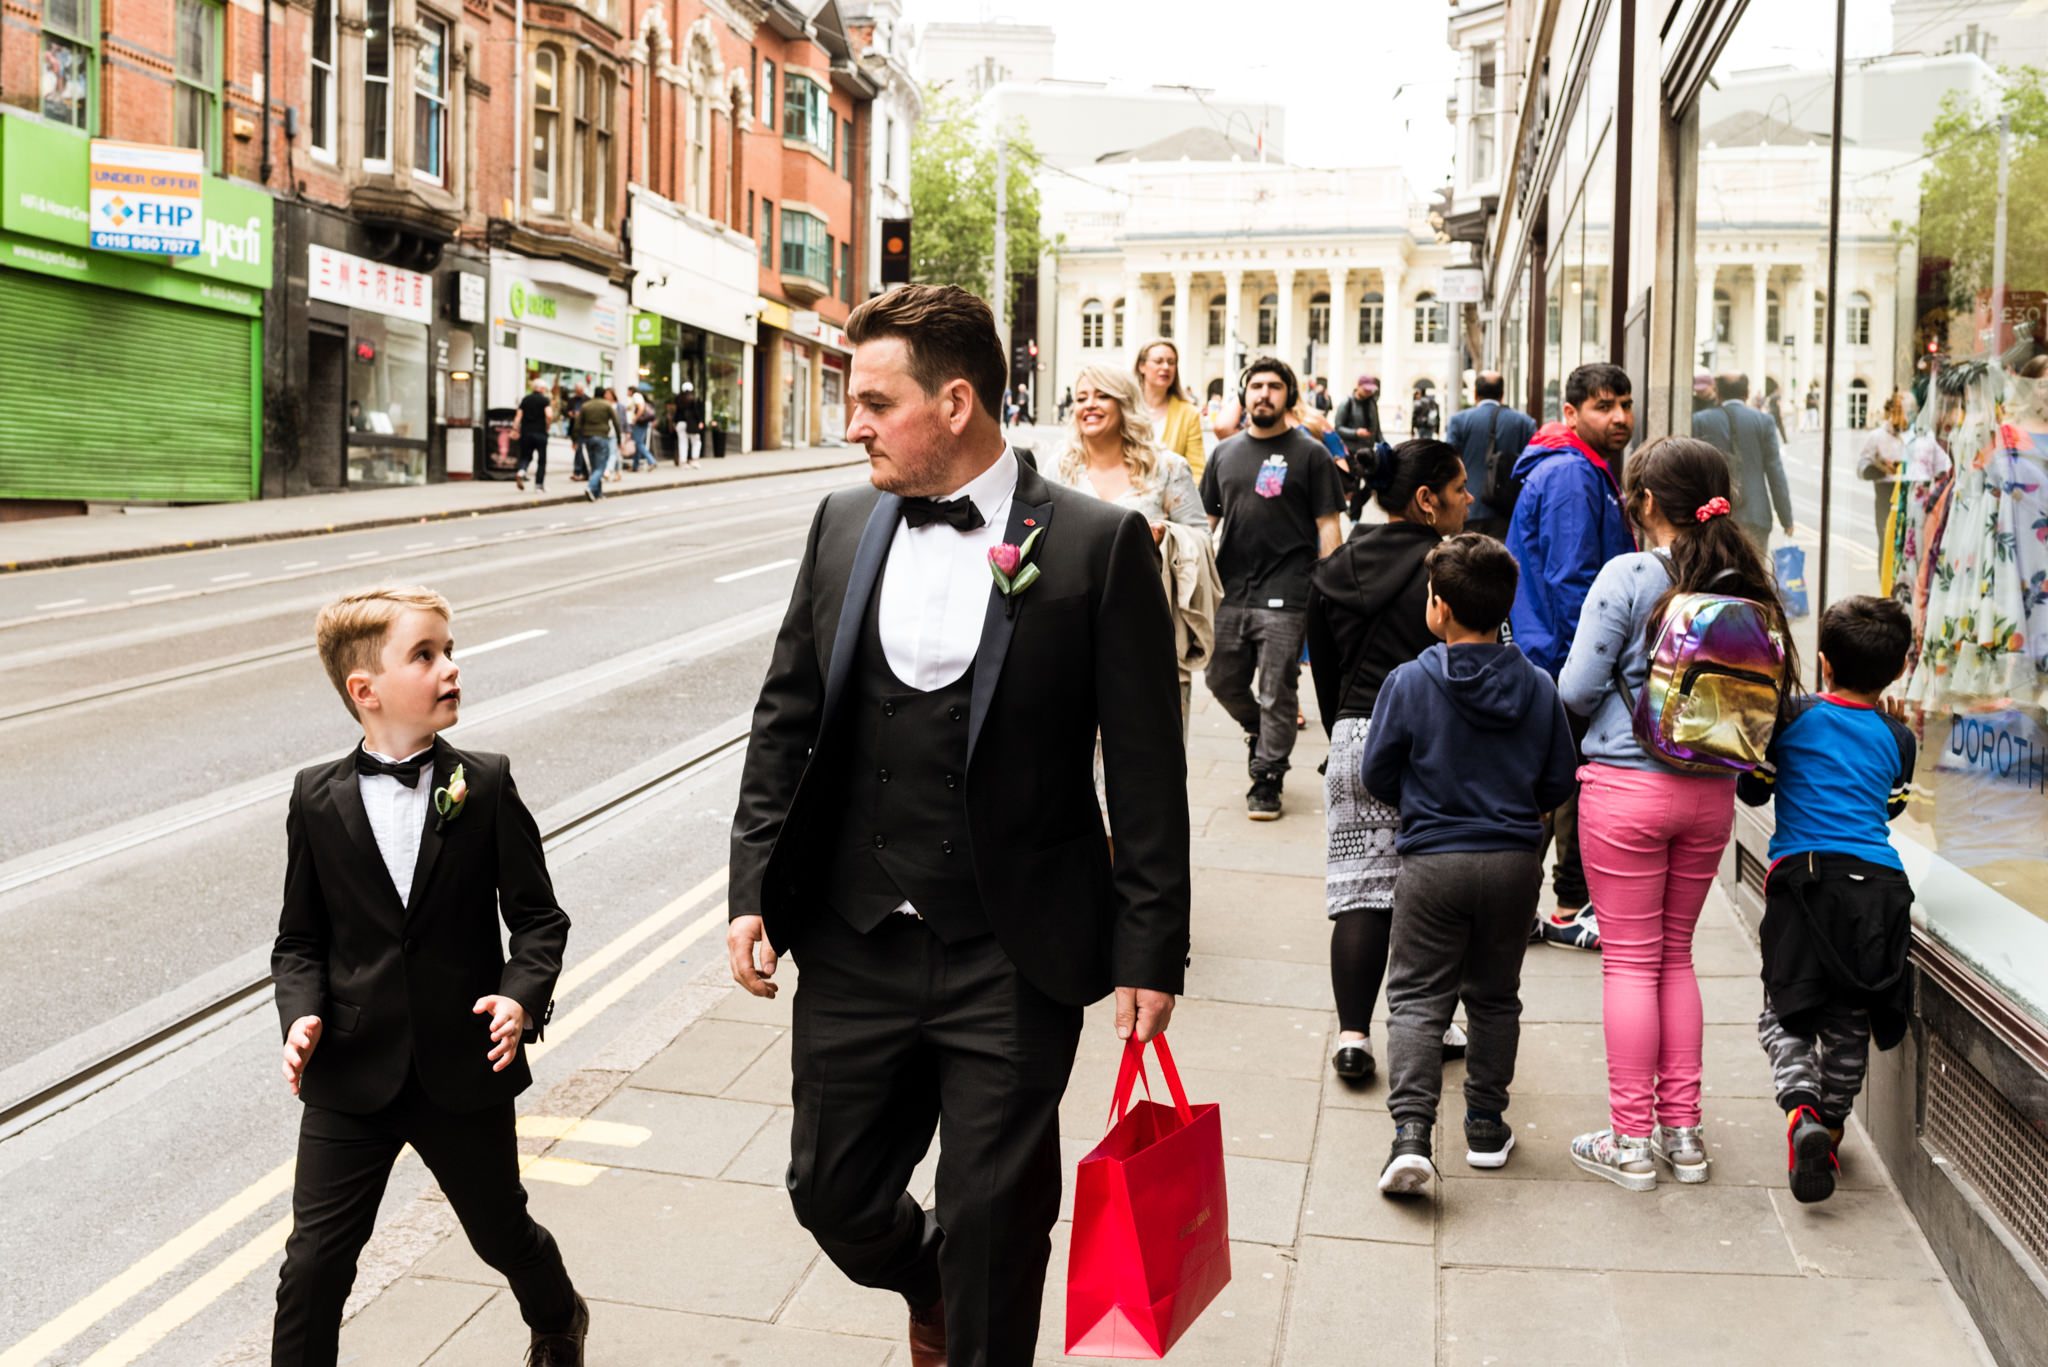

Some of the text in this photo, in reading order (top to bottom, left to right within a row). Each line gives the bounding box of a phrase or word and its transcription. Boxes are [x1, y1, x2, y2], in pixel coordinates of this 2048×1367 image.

[95, 170, 198, 190] UNDER OFFER
[139, 202, 193, 227] FHP
[96, 232, 130, 249] 0115
[1160, 247, 1356, 260] THEATRE ROYAL
[2000, 306, 2041, 323] £30
[1951, 712, 2045, 795] DOROTH
